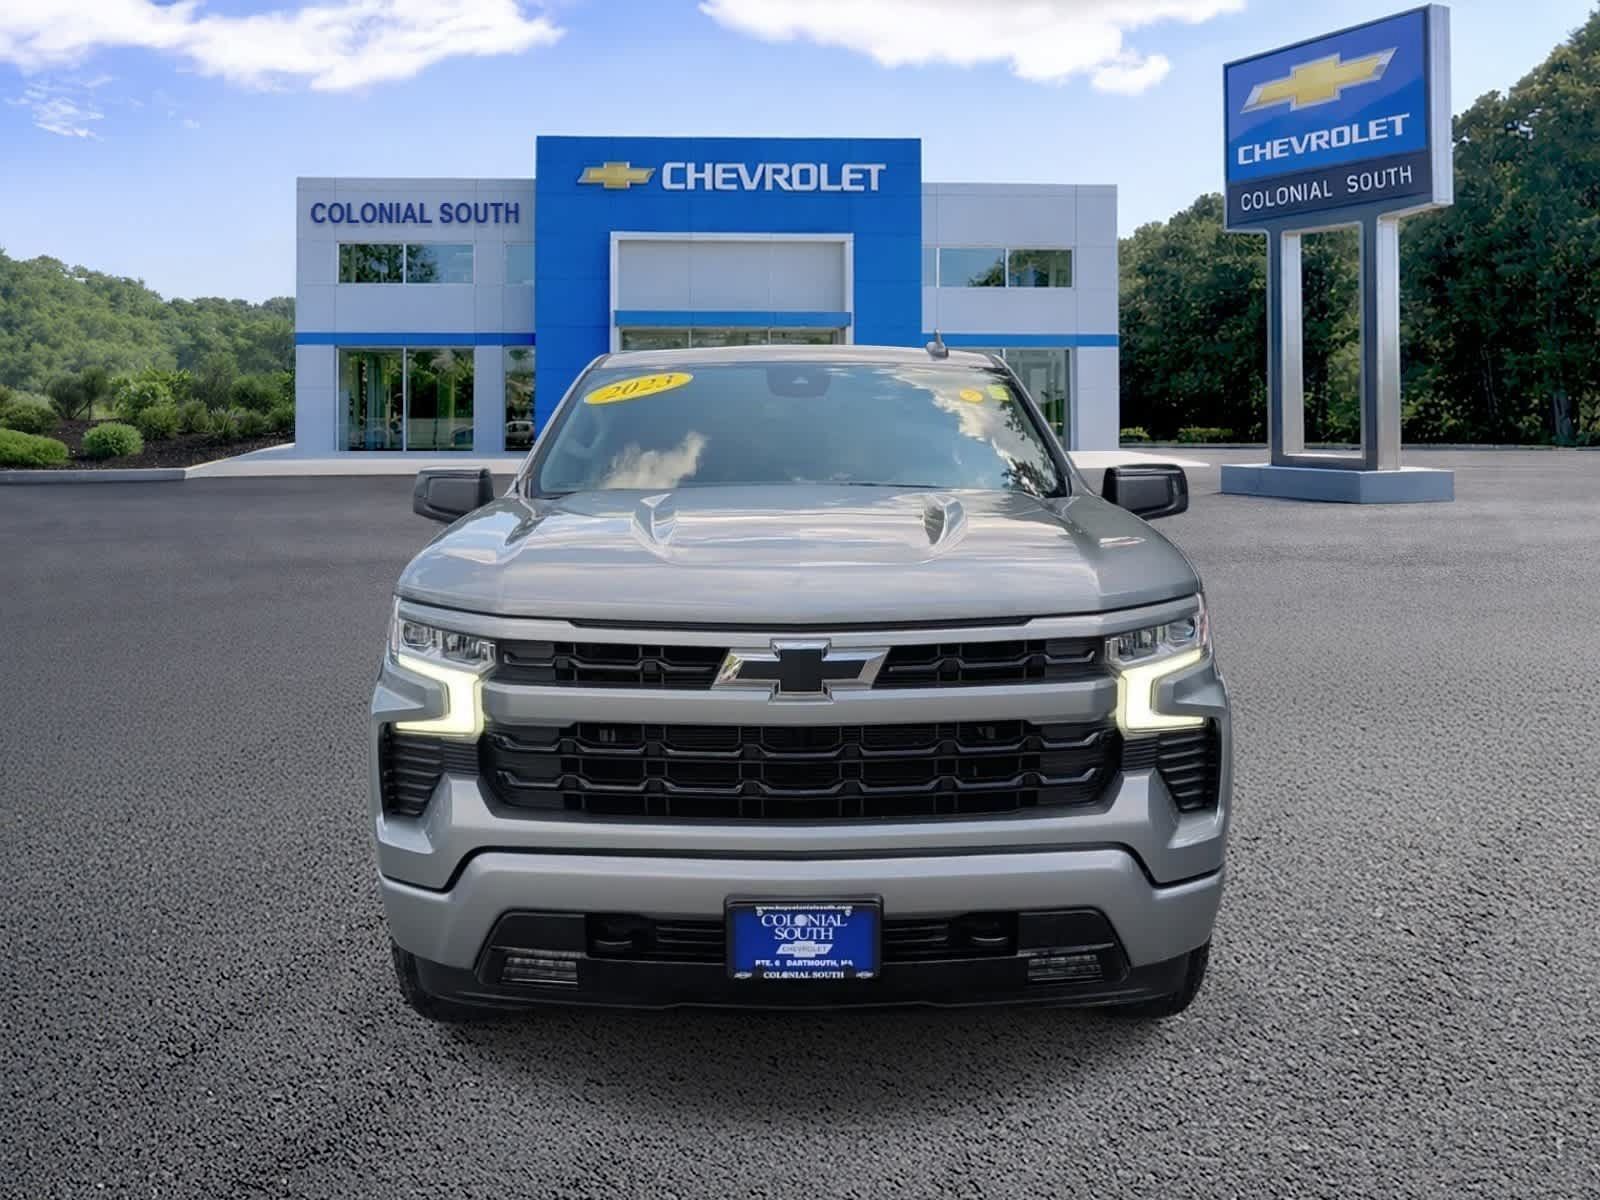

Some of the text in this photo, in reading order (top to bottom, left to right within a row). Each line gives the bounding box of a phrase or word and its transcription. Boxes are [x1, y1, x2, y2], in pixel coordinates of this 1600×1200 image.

[1237, 113, 1410, 165] CHEVROLET
[661, 162, 887, 192] CHEVROLET
[1241, 165, 1412, 211] COLONIAL SOUTH
[311, 202, 520, 225] COLONIAL SOUTH
[761, 914, 848, 927] COLONIAL
[774, 927, 834, 940] SOUTH
[782, 944, 828, 953] CHEVROLET
[763, 971, 845, 979] COLONIAL SOUTH
